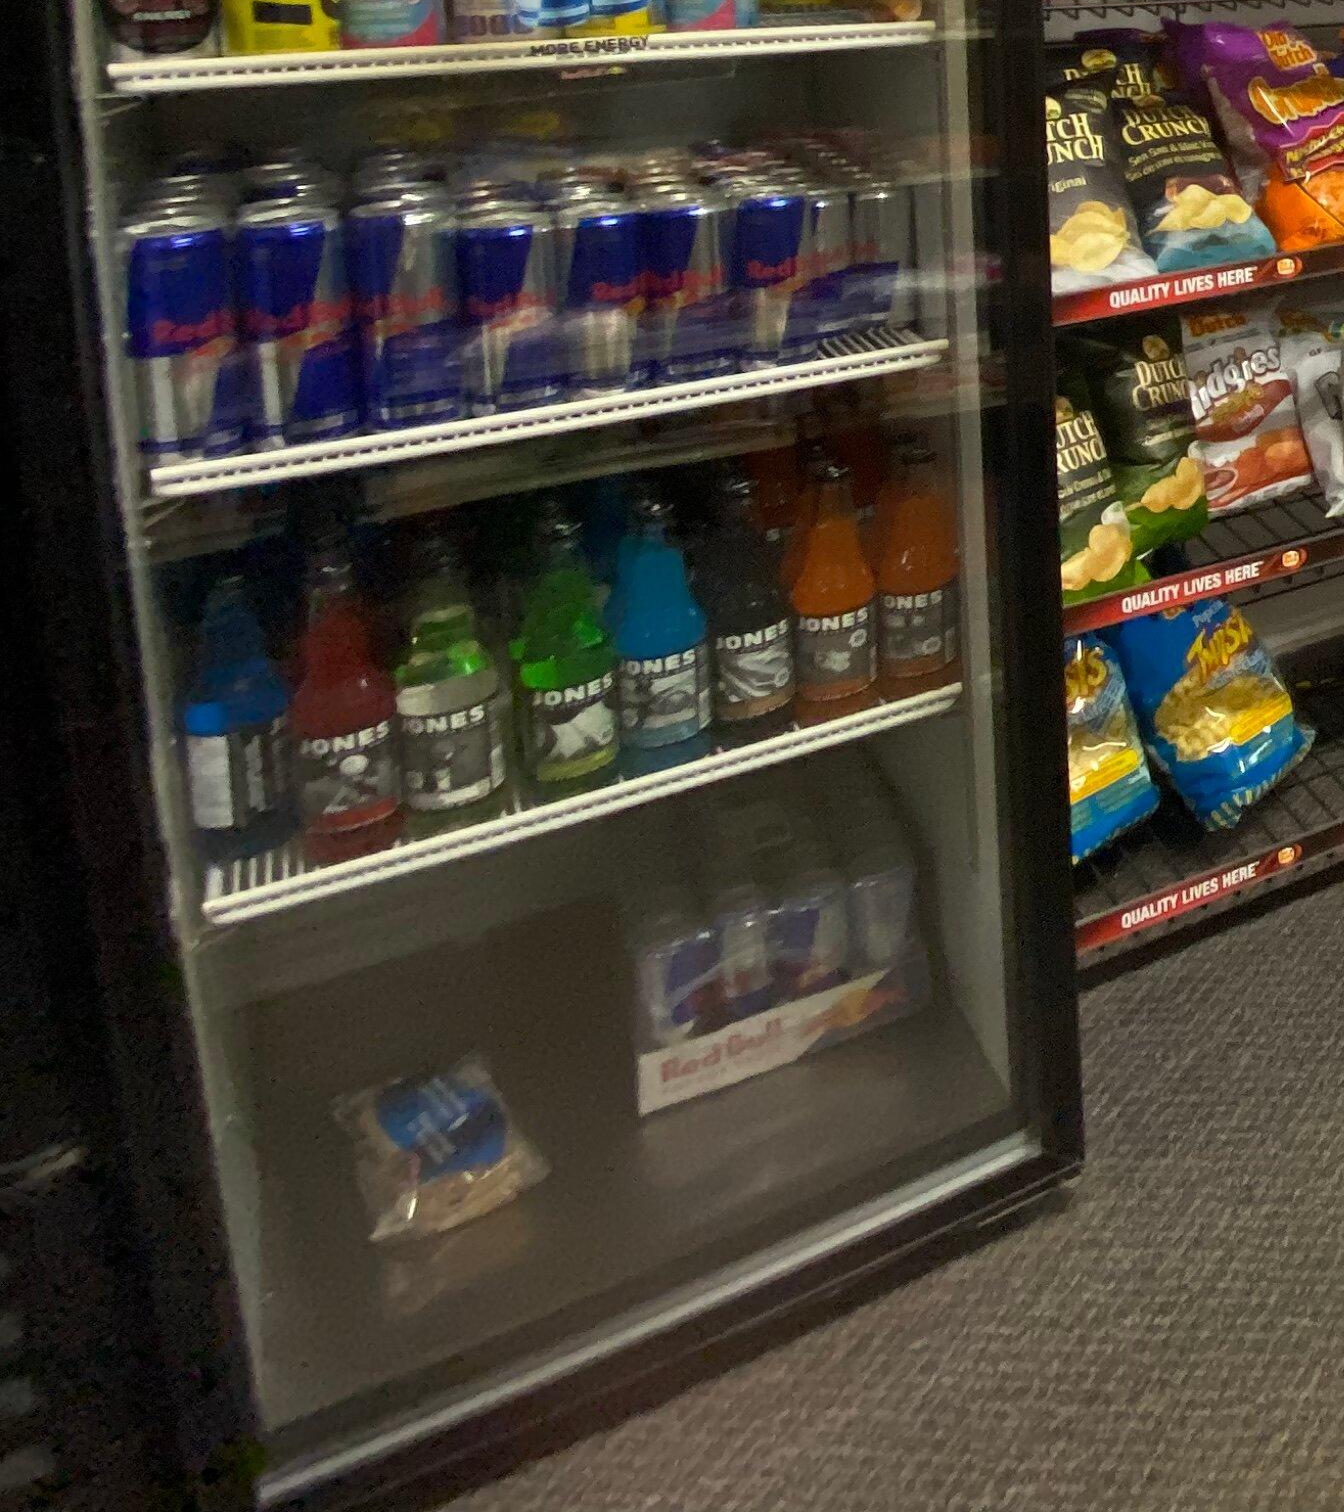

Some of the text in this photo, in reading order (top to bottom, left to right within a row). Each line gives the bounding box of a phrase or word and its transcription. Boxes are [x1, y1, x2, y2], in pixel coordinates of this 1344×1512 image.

[530, 37, 650, 56] MORE ENERGY
[1109, 267, 1257, 309] QUALITY LIVES HERE
[1135, 357, 1185, 387] DUTC
[1056, 409, 1099, 449] UTCH
[883, 589, 943, 610] ONES
[1121, 562, 1263, 614] QUALITY LIVES HERE
[716, 619, 789, 651] JONES
[1121, 861, 1260, 930] QUALITY LIVES HERE
